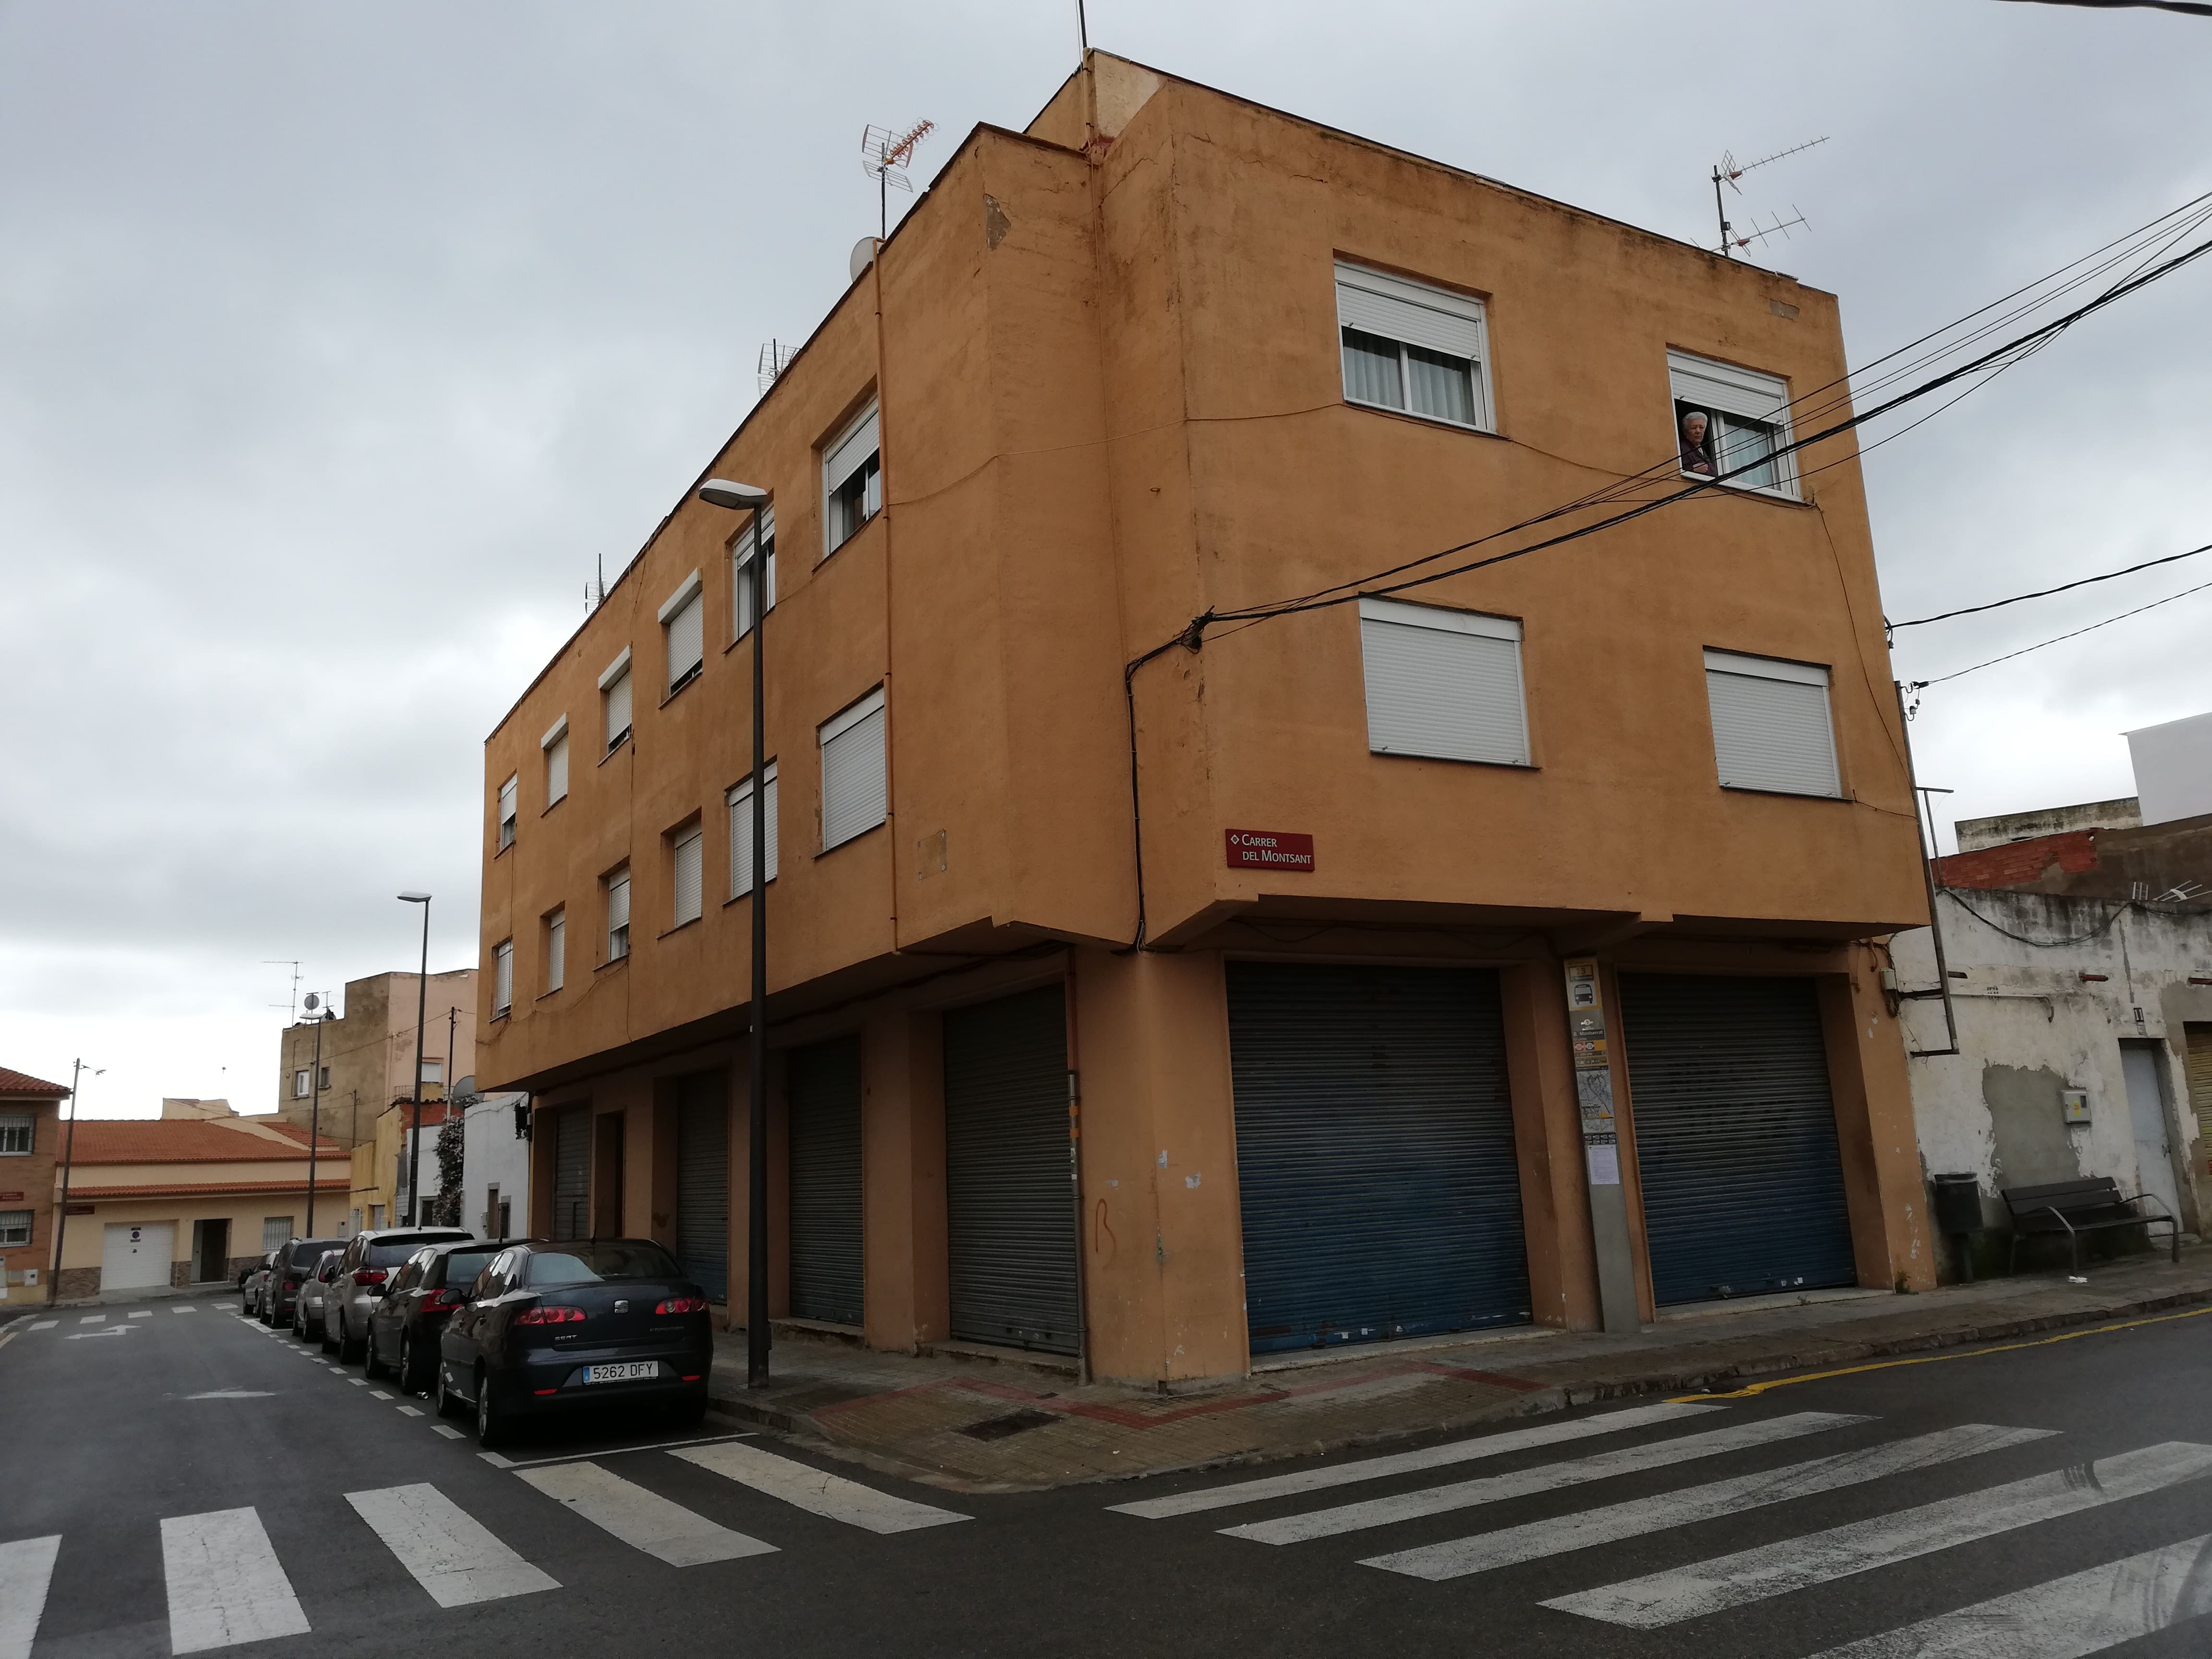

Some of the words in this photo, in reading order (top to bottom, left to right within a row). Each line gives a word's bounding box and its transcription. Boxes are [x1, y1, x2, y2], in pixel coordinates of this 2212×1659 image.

[1241, 834, 1278, 848] CARRER
[1242, 851, 1260, 861] DEL
[1261, 850, 1311, 864] MONTSANT
[593, 1365, 625, 1379] 5262
[630, 1363, 653, 1376] DFY
